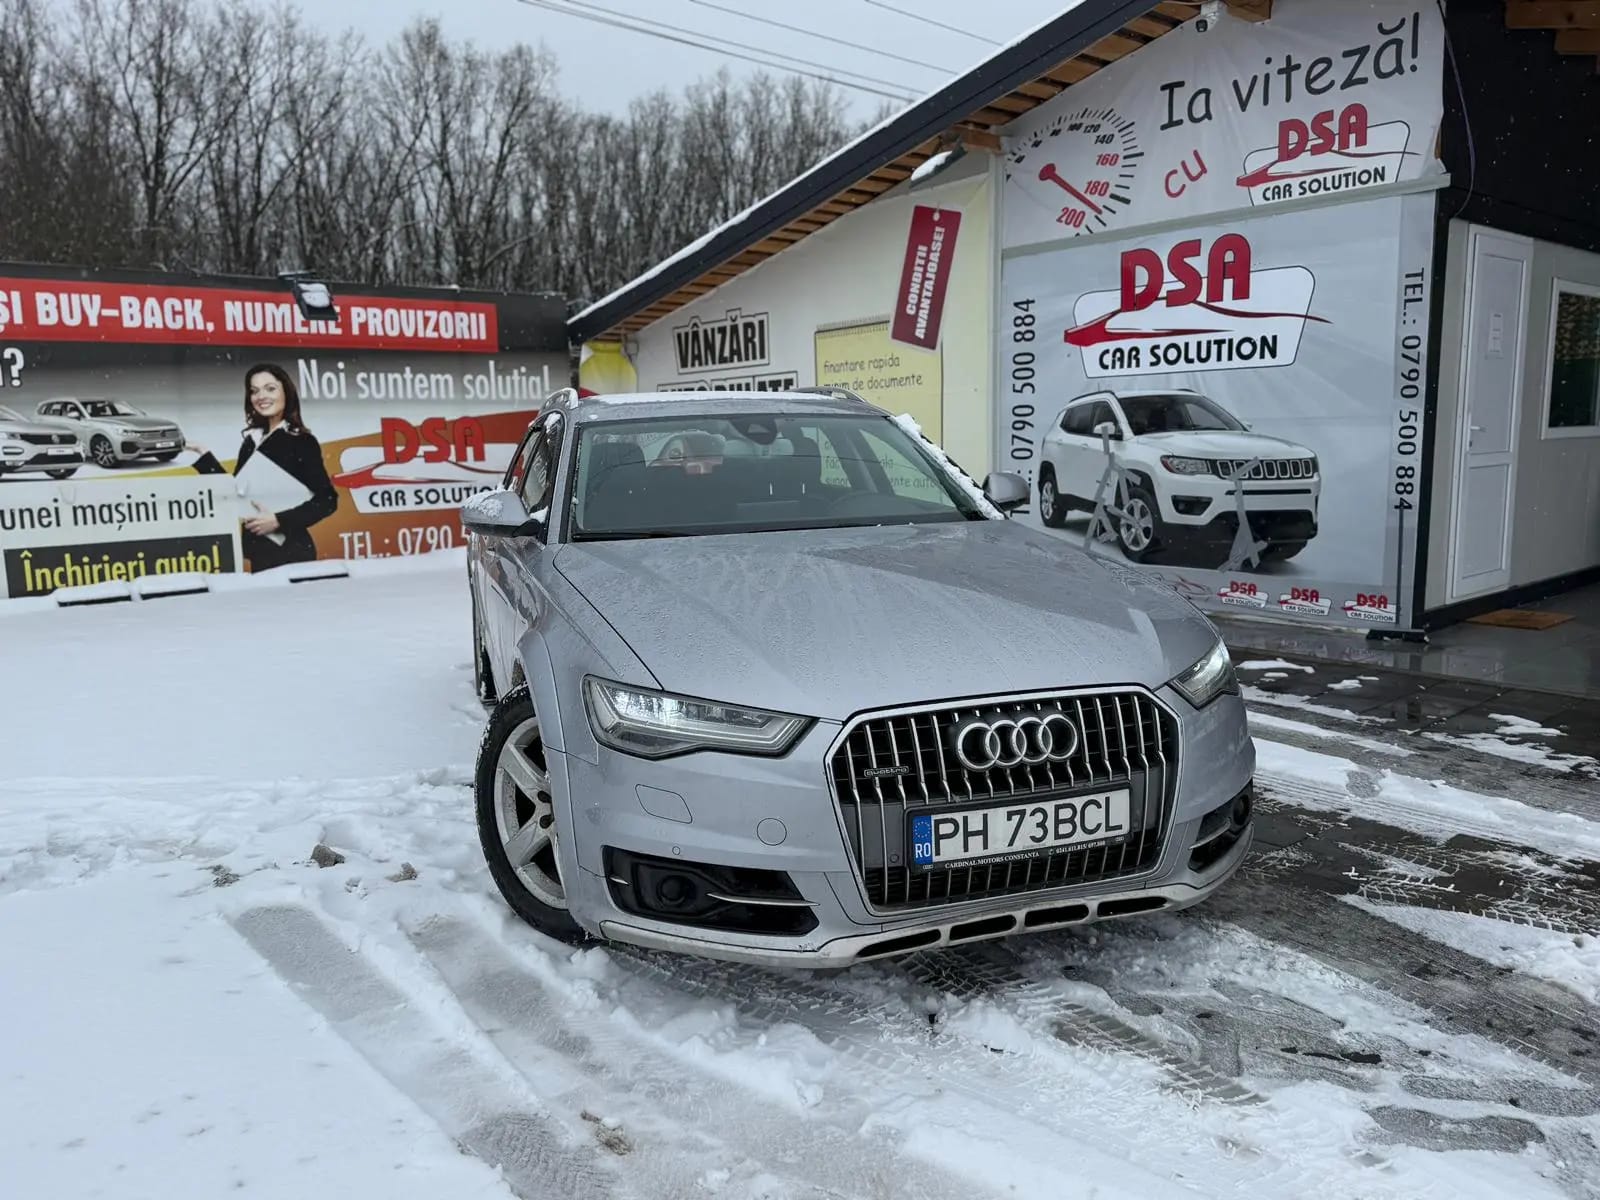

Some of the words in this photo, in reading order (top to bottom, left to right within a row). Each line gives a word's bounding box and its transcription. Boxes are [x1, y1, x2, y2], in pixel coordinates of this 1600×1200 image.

[1160, 81, 1212, 130] Ia
[1232, 12, 1420, 112] viteză!
[1094, 134, 1115, 144] 140
[1278, 103, 1368, 162] DSA
[1096, 153, 1119, 166] 160
[1164, 150, 1208, 198] cu
[1084, 180, 1110, 197] 180
[1262, 184, 1292, 201] CAR
[1299, 166, 1386, 195] SOLUTION
[1056, 207, 1086, 228] 200
[1121, 233, 1251, 312] DSA
[35, 292, 215, 333] BUY-BACK,
[350, 307, 487, 341] PROVIZORII
[1402, 267, 1424, 325] TEL.:
[1013, 298, 1036, 343] 884
[676, 315, 766, 368] VÂNZĂRI
[1099, 346, 1140, 370] CAR
[1150, 335, 1278, 367] SOLUTION
[298, 359, 346, 400] Noi
[356, 366, 453, 400] suntem
[853, 377, 865, 390] de
[867, 374, 922, 390] documente
[1012, 352, 1036, 394] 500
[1400, 335, 1421, 399] 0790
[381, 416, 485, 464] DSA
[1011, 404, 1034, 460] 0790
[1397, 410, 1417, 455] 500
[368, 490, 406, 507] CAR
[1394, 466, 1415, 510] 884
[0, 498, 61, 530] unei
[72, 493, 158, 530] mașini
[168, 489, 215, 519] noi!
[398, 525, 452, 556] 0790
[20, 550, 146, 591] Închirieri
[156, 545, 220, 577] auto!
[1230, 581, 1257, 595] DSA
[1291, 587, 1319, 602] DSA
[1357, 593, 1388, 608] DSA
[934, 813, 988, 857] PH
[1006, 797, 1122, 847] 73BCL
[915, 842, 931, 859] RO
[978, 855, 1003, 866] MOTORS
